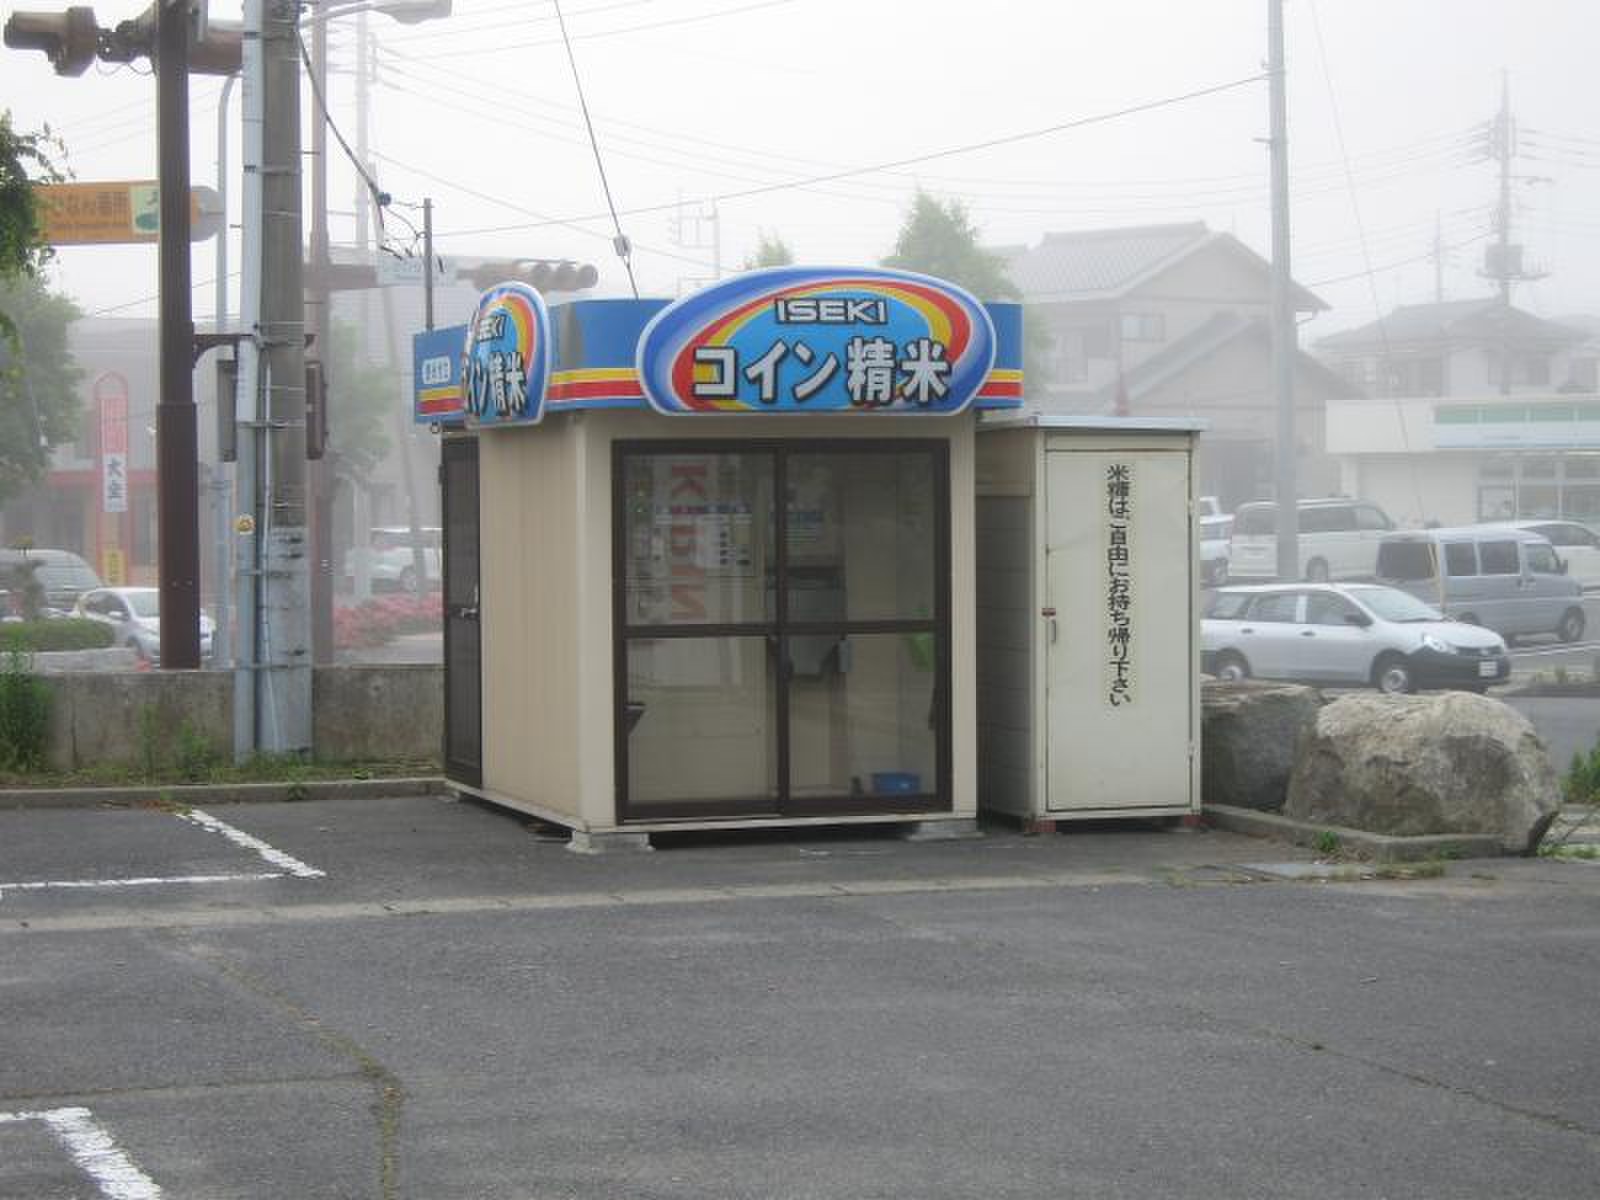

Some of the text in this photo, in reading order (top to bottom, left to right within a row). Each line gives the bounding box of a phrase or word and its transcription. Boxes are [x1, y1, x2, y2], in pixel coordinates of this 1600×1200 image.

[775, 298, 887, 324] ISEKI
[693, 335, 951, 405] コイン精米
